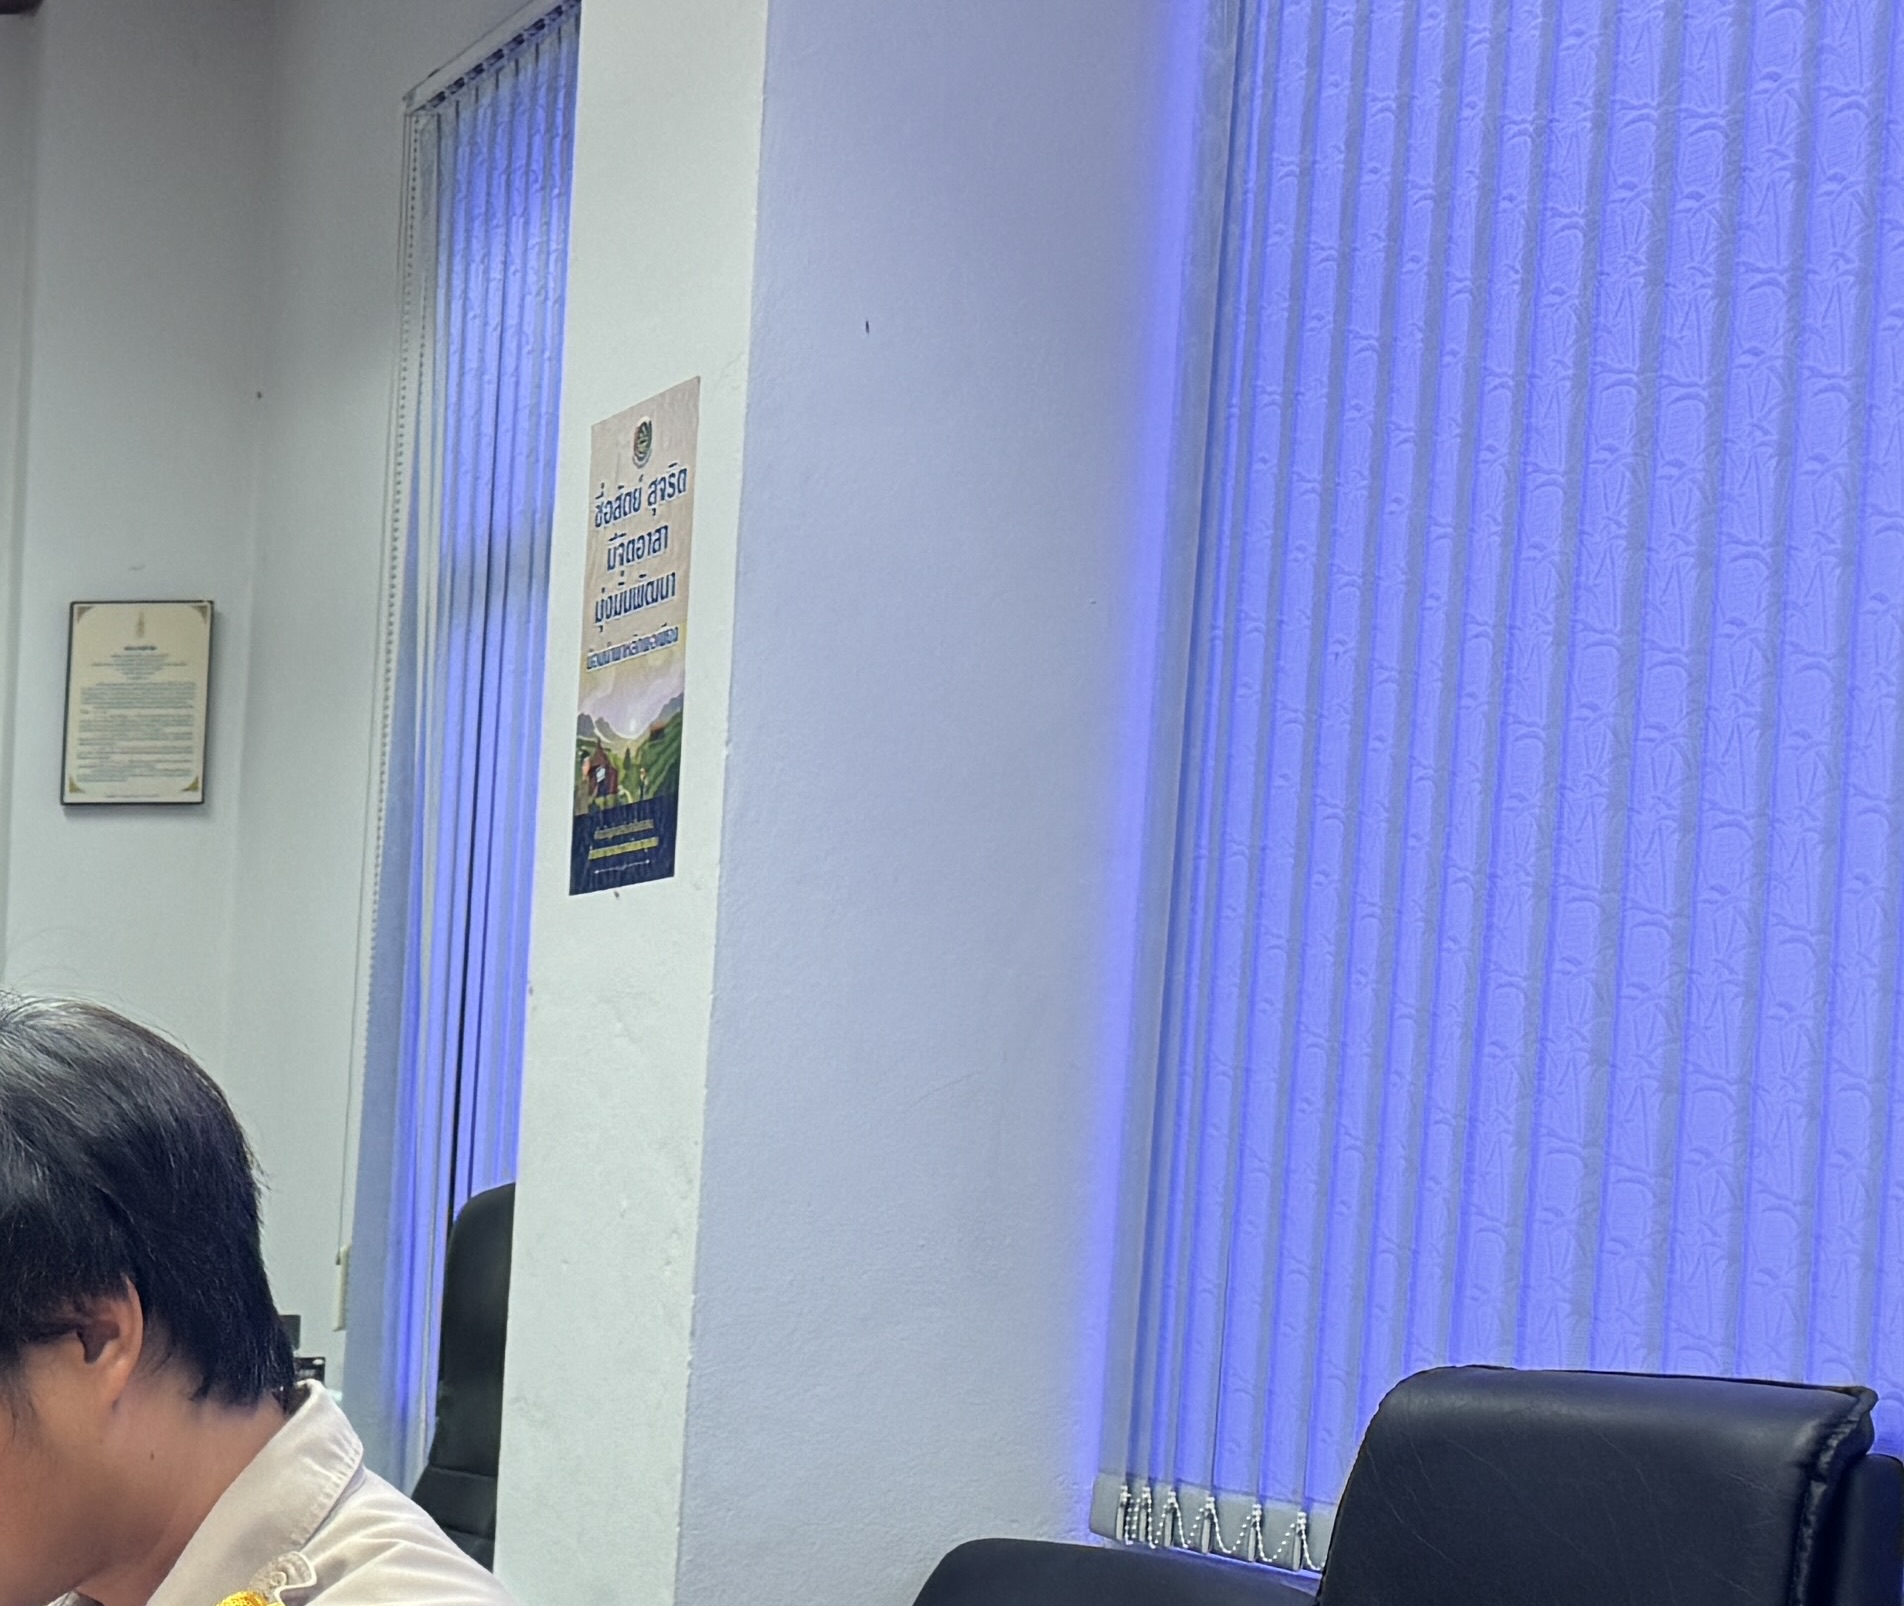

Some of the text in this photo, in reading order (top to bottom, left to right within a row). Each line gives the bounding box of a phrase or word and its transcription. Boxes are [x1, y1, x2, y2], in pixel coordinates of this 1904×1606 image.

[594, 462, 688, 528] ซื่อสัตย์ สุจริต
[607, 524, 669, 571] มีจิตอาสา
[594, 570, 676, 634] มุ่งมั่นพัฒนา
